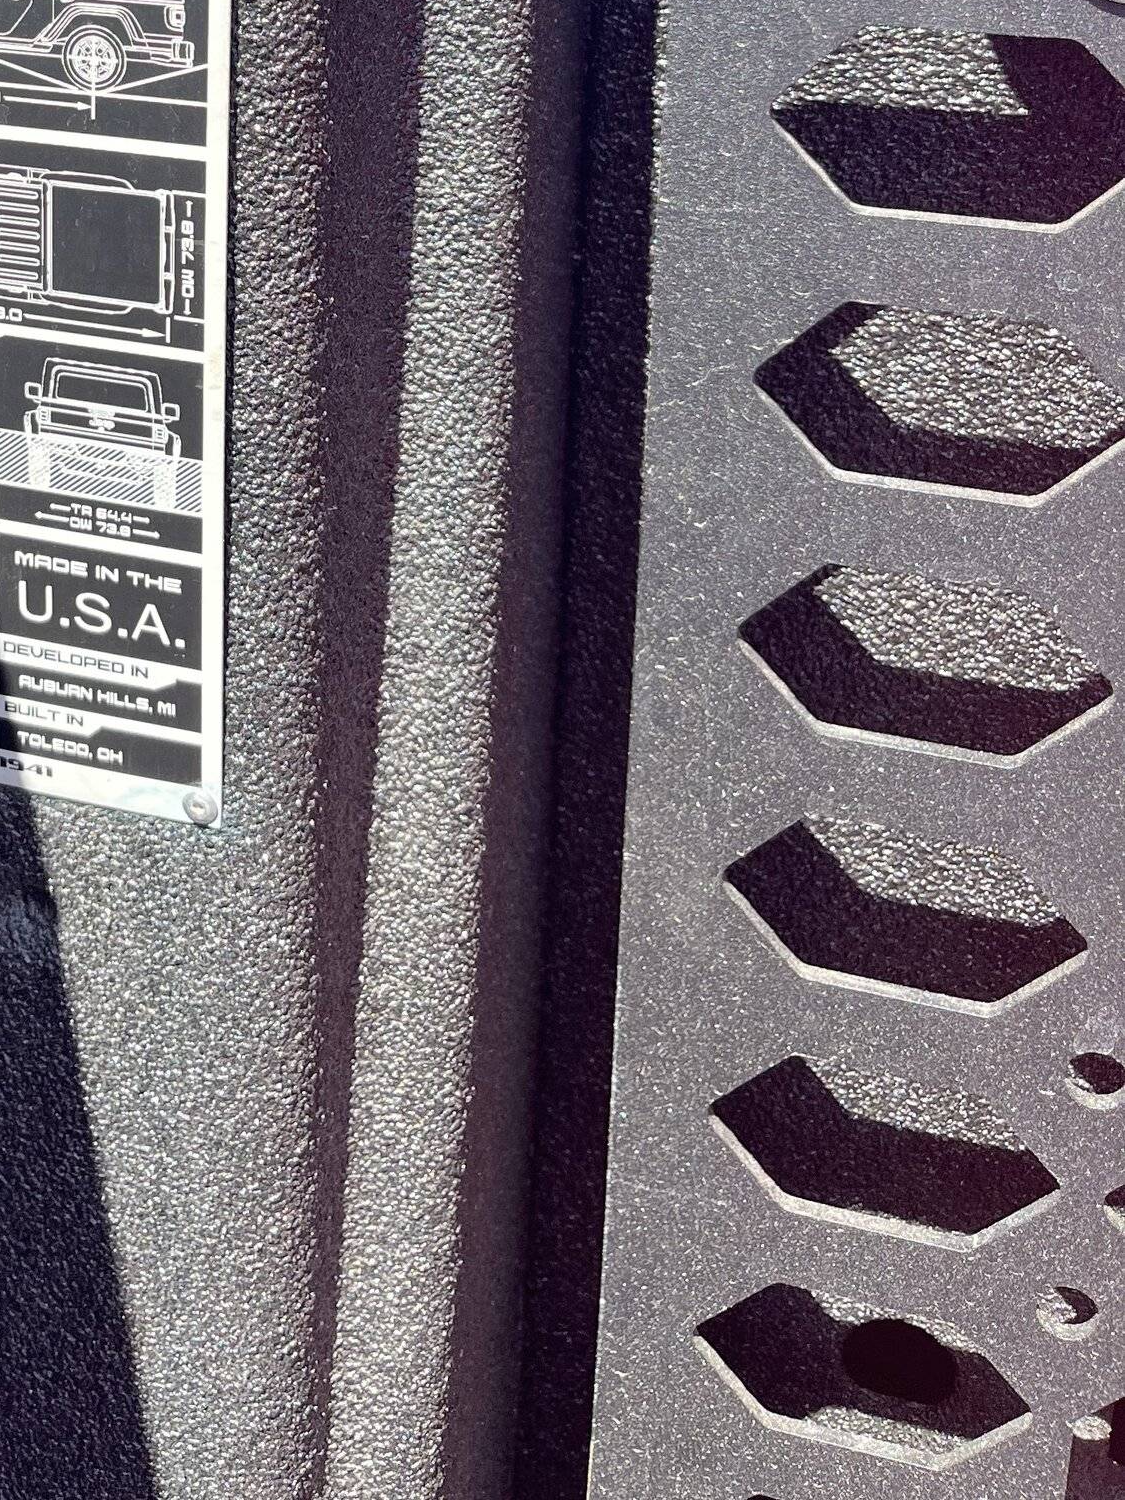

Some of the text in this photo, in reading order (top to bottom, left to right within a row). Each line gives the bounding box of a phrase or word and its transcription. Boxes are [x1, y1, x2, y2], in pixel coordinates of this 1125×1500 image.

[14, 550, 182, 595] MADE IN THE
[17, 579, 186, 649] U.S.A.
[3, 641, 149, 679] DEVELOPED IN
[4, 700, 84, 727] BUILT IN
[18, 674, 177, 718] AUBURN HILLS, MI
[16, 730, 123, 766] TOLEDO, OH
